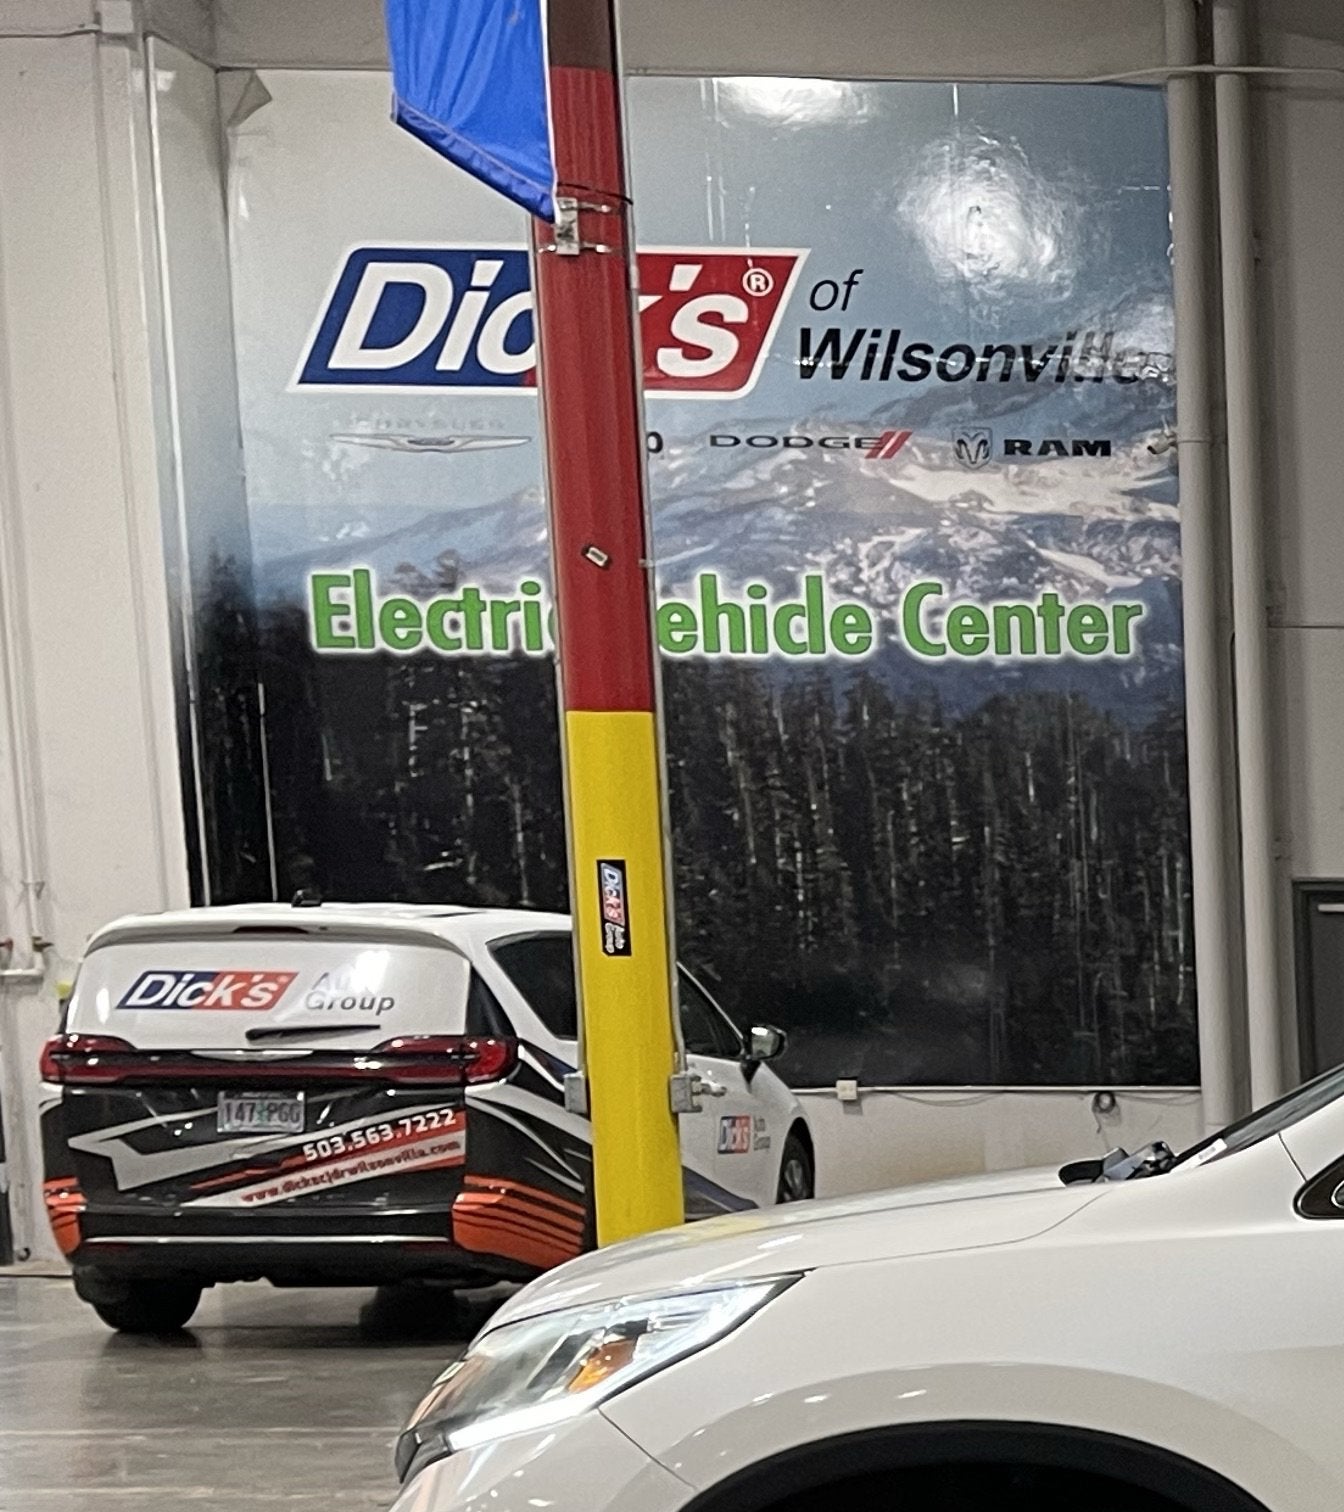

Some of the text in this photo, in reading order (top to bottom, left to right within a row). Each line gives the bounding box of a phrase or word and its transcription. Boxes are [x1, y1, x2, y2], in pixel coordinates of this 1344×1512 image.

[809, 268, 864, 312] of
[328, 260, 749, 378] Dic's
[709, 434, 884, 450] DODGE
[1003, 438, 1112, 457] RAM
[311, 568, 1143, 657] Electri ehicle Center
[125, 973, 280, 1009] Dick's
[305, 991, 395, 1016] Group
[302, 1107, 458, 1162] 503.563.7222
